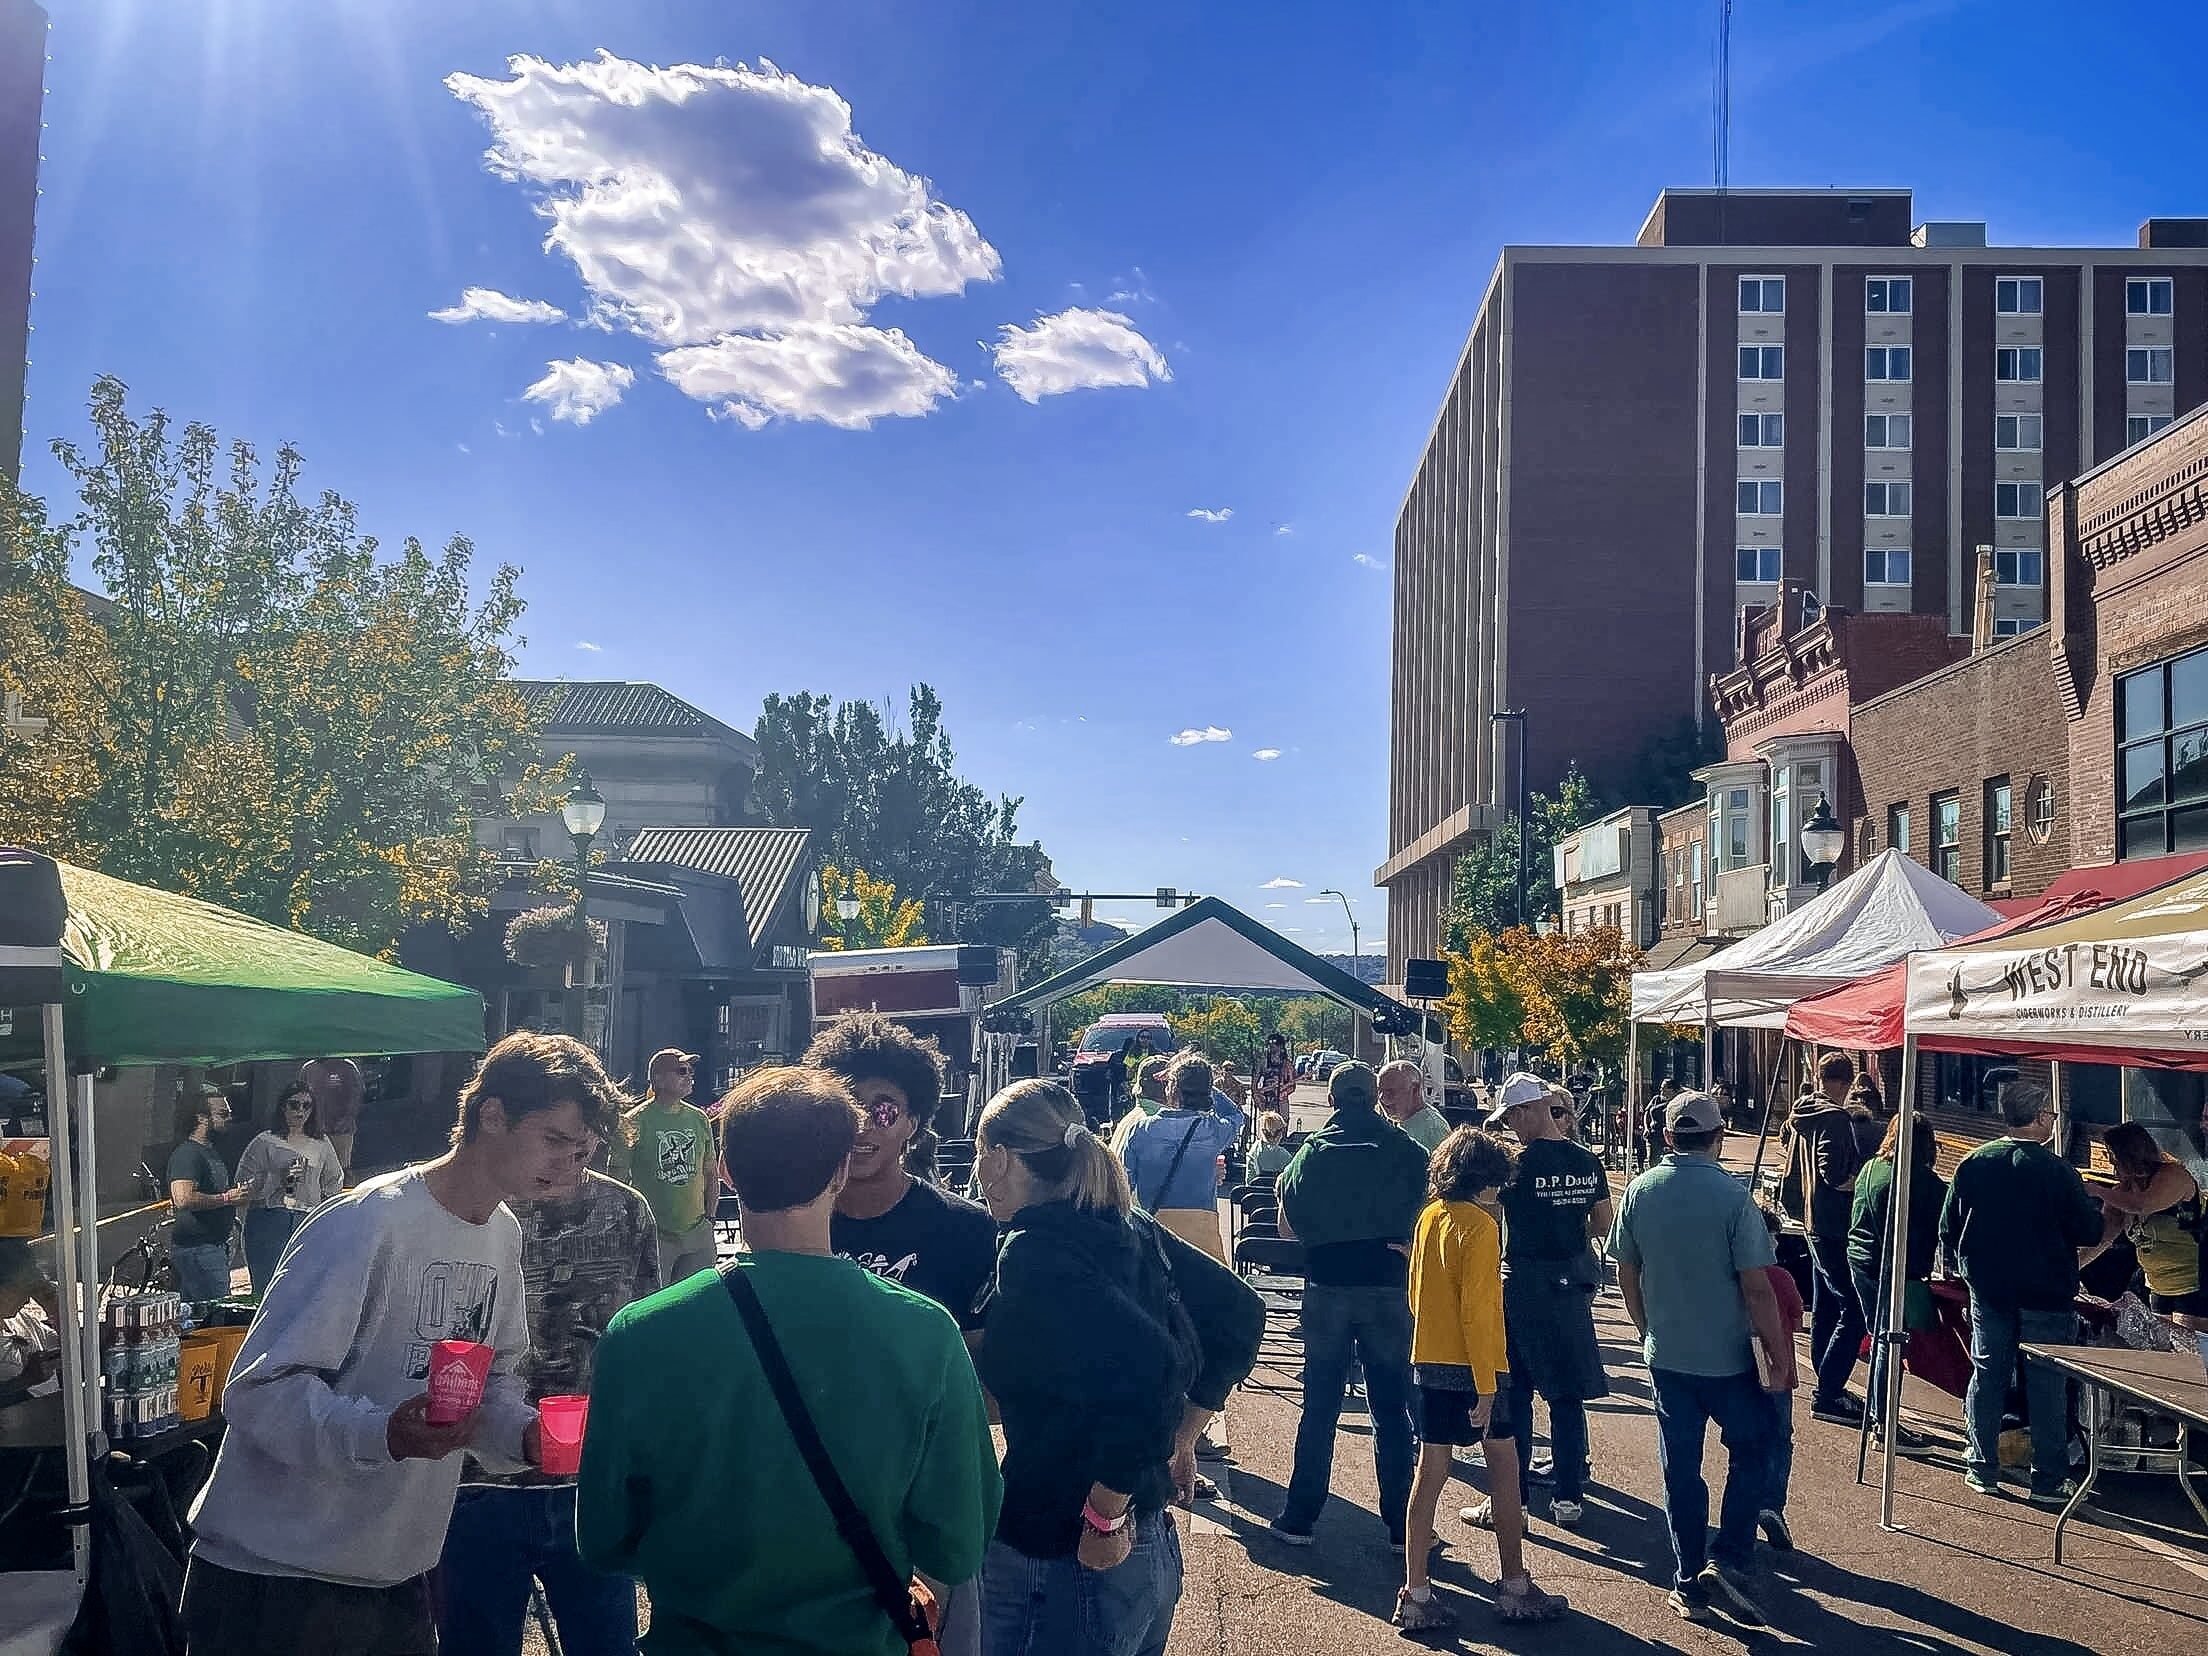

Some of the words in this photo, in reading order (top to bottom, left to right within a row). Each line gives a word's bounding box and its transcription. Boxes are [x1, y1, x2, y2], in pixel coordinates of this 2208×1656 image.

[2004, 943, 2078, 1001] WEST
[2090, 944, 2148, 996] END
[2016, 1007, 2067, 1020] CIDERWORKS
[2079, 1004, 2129, 1019] DISTILLERY
[1535, 1175, 1562, 1188] D.P.
[1565, 1171, 1598, 1187] Dough
